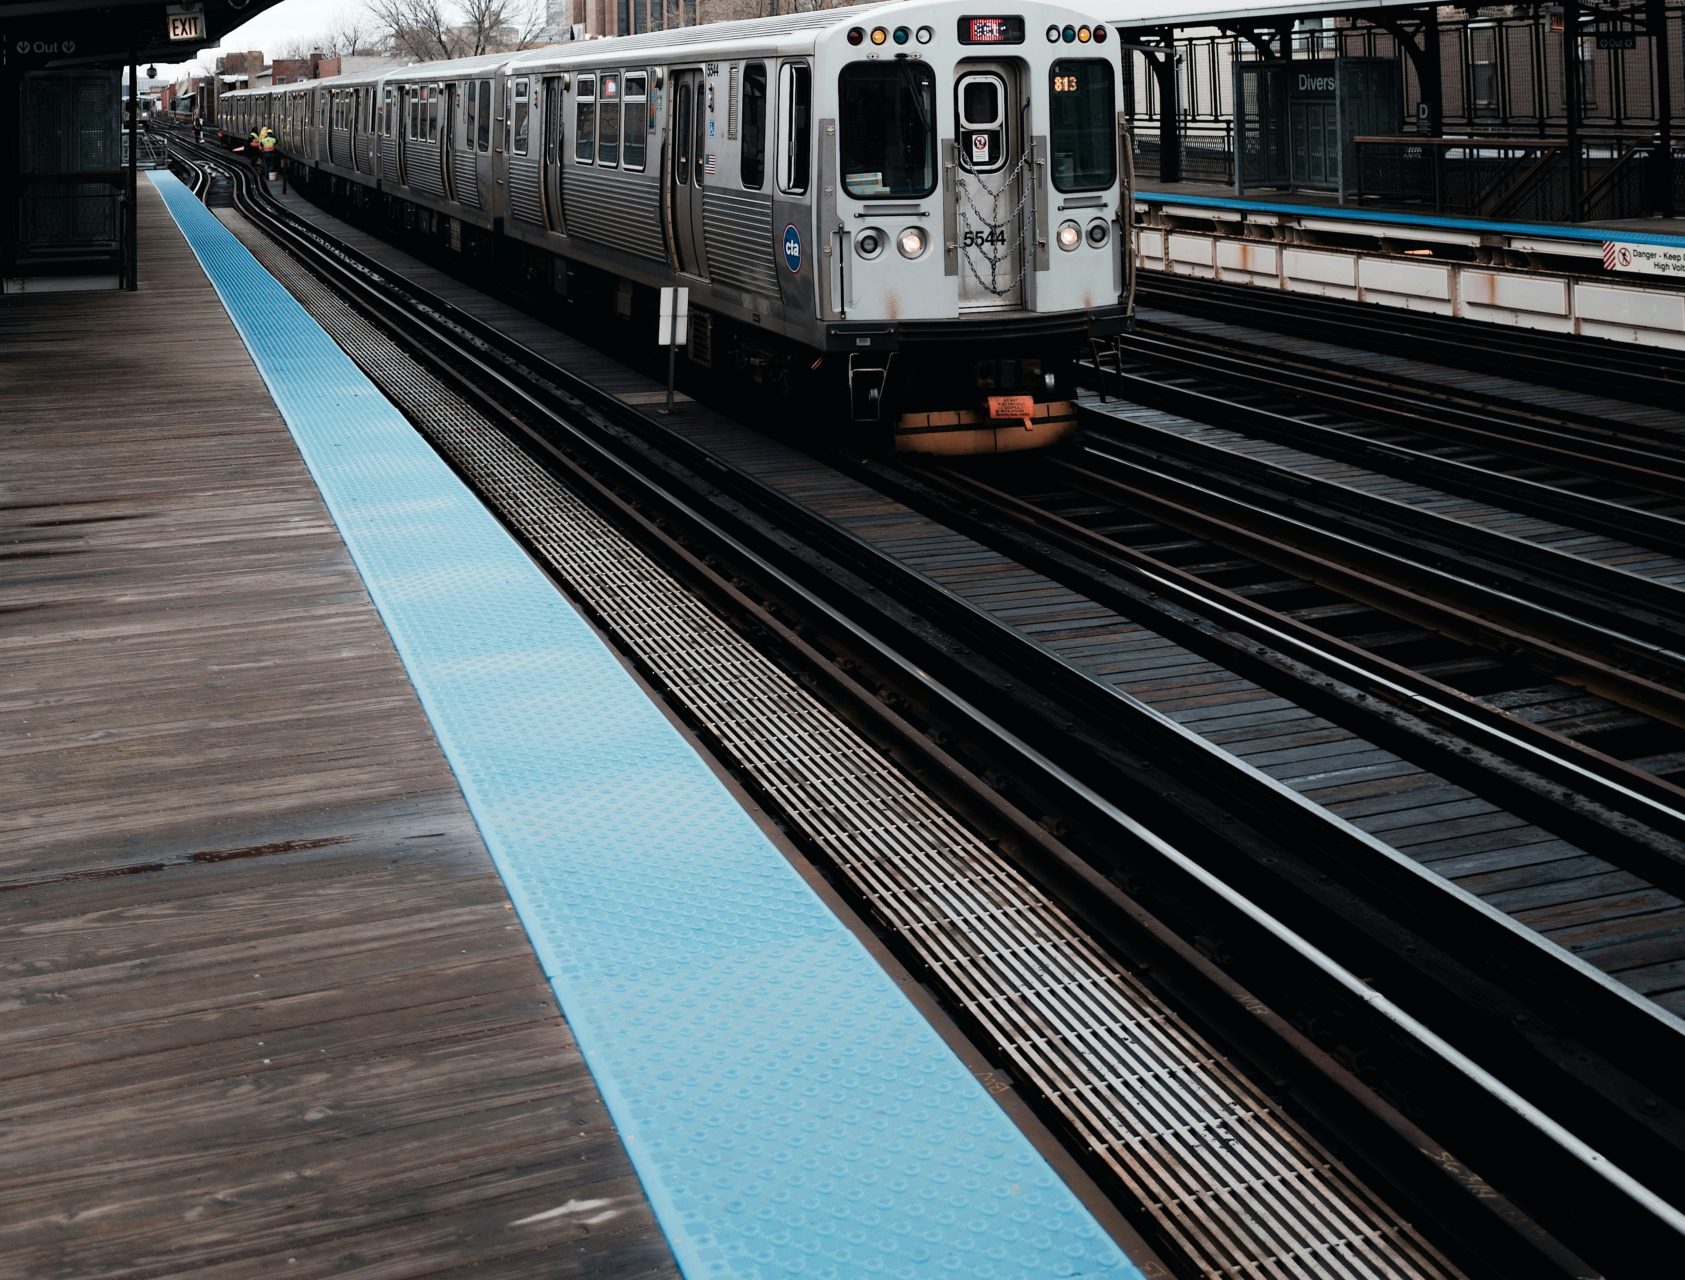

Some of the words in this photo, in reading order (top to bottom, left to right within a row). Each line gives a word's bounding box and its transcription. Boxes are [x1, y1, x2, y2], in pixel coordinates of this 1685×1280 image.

[172, 17, 198, 36] EXIT
[33, 41, 58, 53] Out
[1054, 76, 1077, 91] 813
[1419, 104, 1428, 119] D
[963, 230, 1007, 247] 5544
[786, 239, 799, 257] cta
[1633, 249, 1657, 261] Danger
[1663, 251, 1681, 263] Keep
[1653, 261, 1670, 272] High
